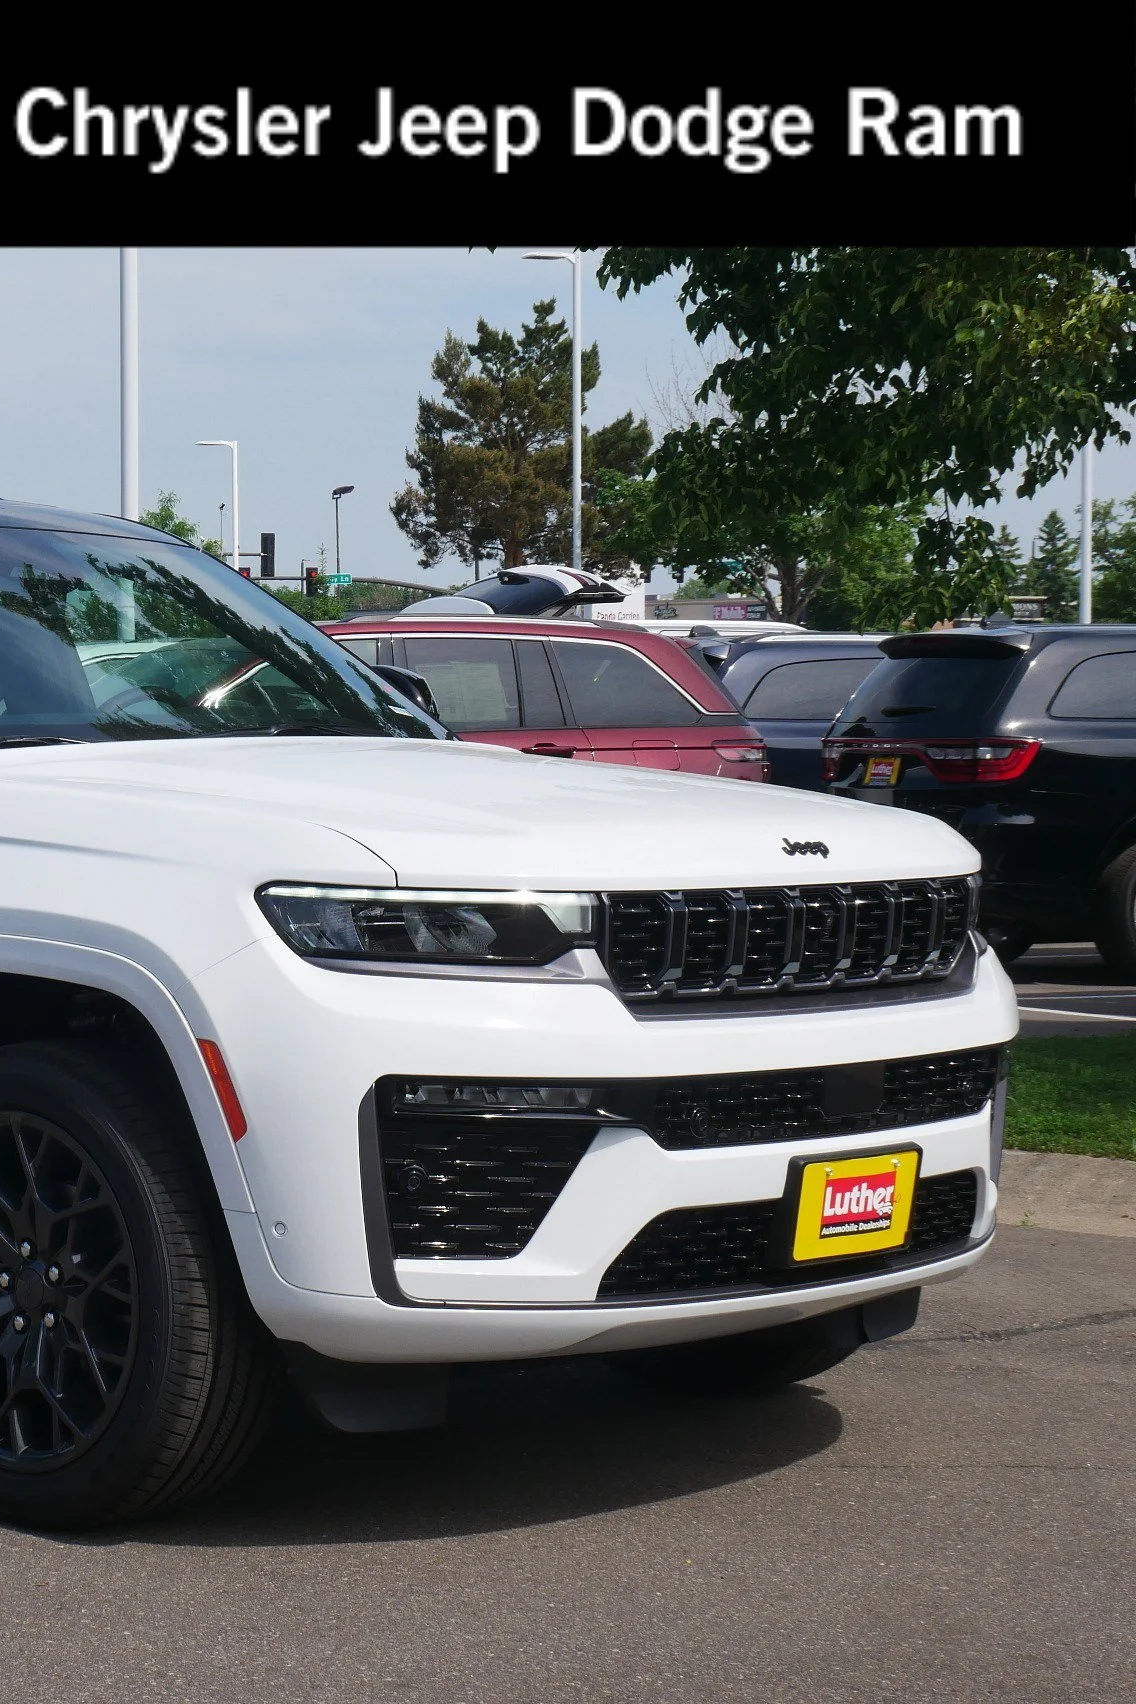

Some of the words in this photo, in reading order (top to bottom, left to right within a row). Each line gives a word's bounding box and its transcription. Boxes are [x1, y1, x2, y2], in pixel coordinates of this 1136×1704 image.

[781, 837, 830, 859] Jeep
[823, 1182, 894, 1216] Luther
[821, 1223, 858, 1235] Automobile
[859, 1219, 891, 1231] Dealerships
